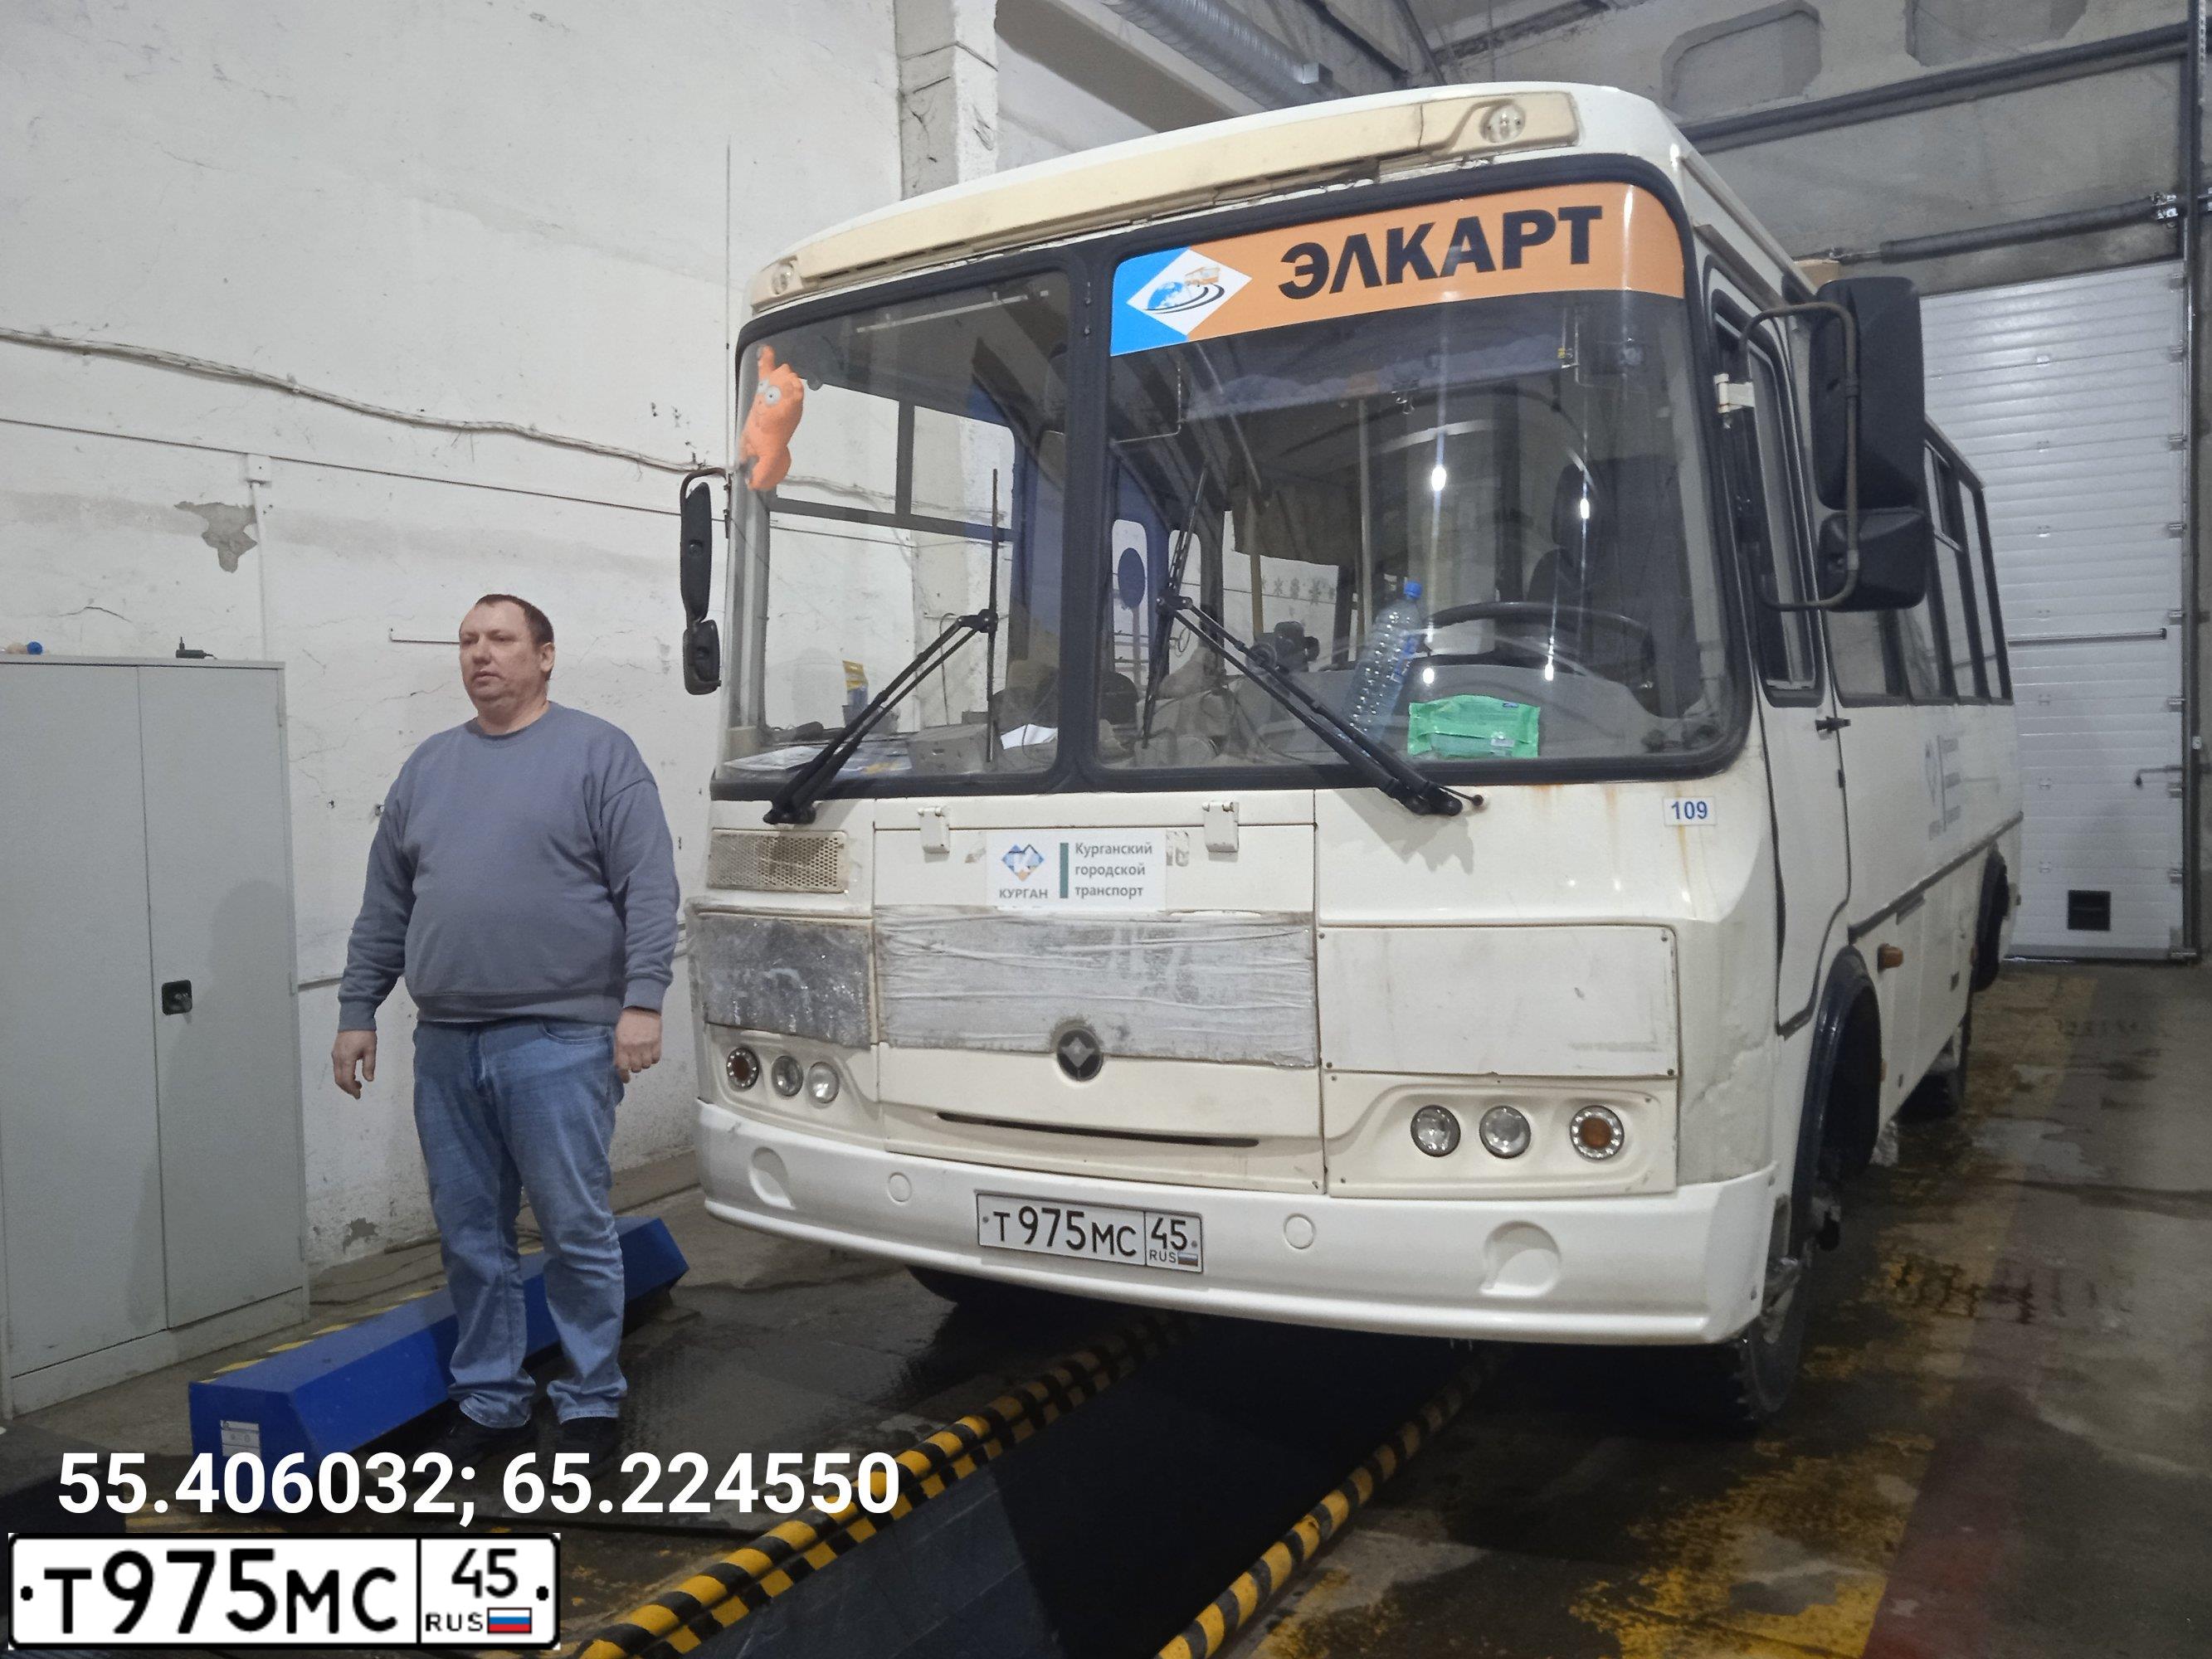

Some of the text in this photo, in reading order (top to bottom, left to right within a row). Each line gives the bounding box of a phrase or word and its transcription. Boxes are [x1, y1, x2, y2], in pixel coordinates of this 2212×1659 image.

[1278, 205, 1603, 300] ЭЛКАРТ
[1671, 800, 1708, 820] 109
[1075, 842, 1152, 858] Курганский
[1075, 863, 1146, 878] городской
[999, 888, 1048, 899] КУРГАН
[1075, 886, 1144, 899] транспорт
[1151, 1217, 1187, 1251] 45
[1149, 1249, 1177, 1263] RUS
